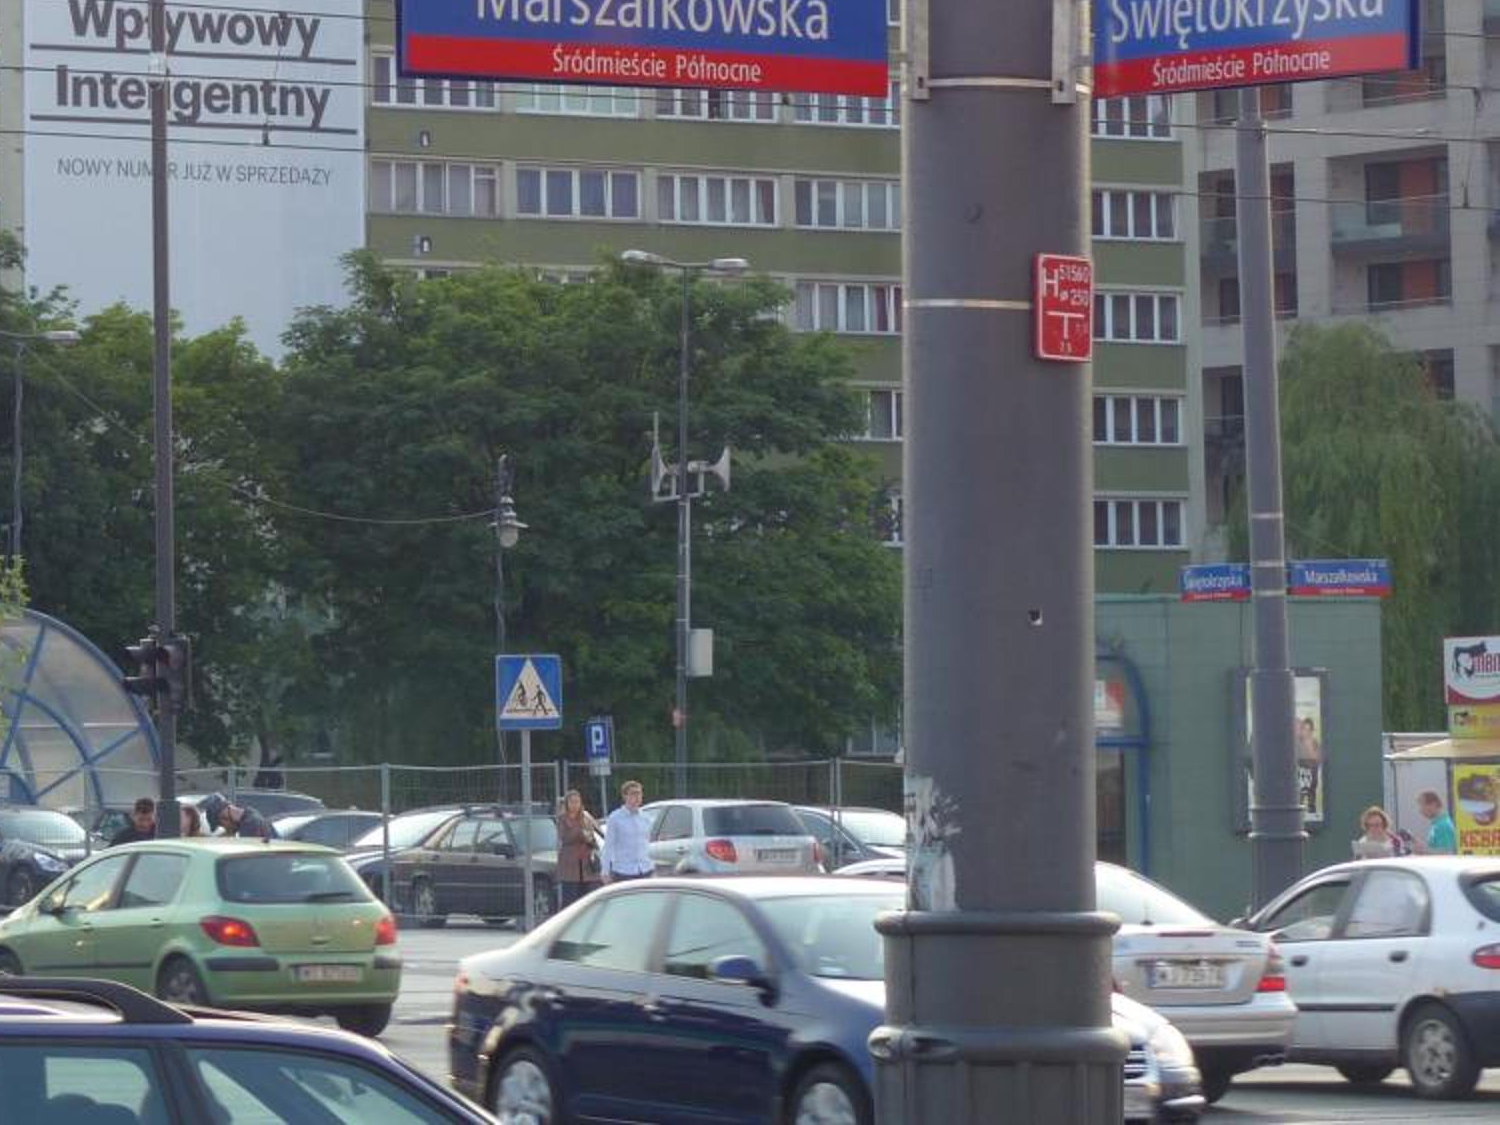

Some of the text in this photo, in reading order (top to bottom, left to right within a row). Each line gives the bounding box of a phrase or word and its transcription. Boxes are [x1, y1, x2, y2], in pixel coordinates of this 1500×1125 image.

[553, 44, 762, 83] Śródmieście Północne
[1152, 47, 1331, 87] Śródmieście Północne
[57, 158, 112, 176] NOWY
[216, 165, 235, 183] W
[1042, 267, 1059, 297] H
[591, 725, 604, 755] P
